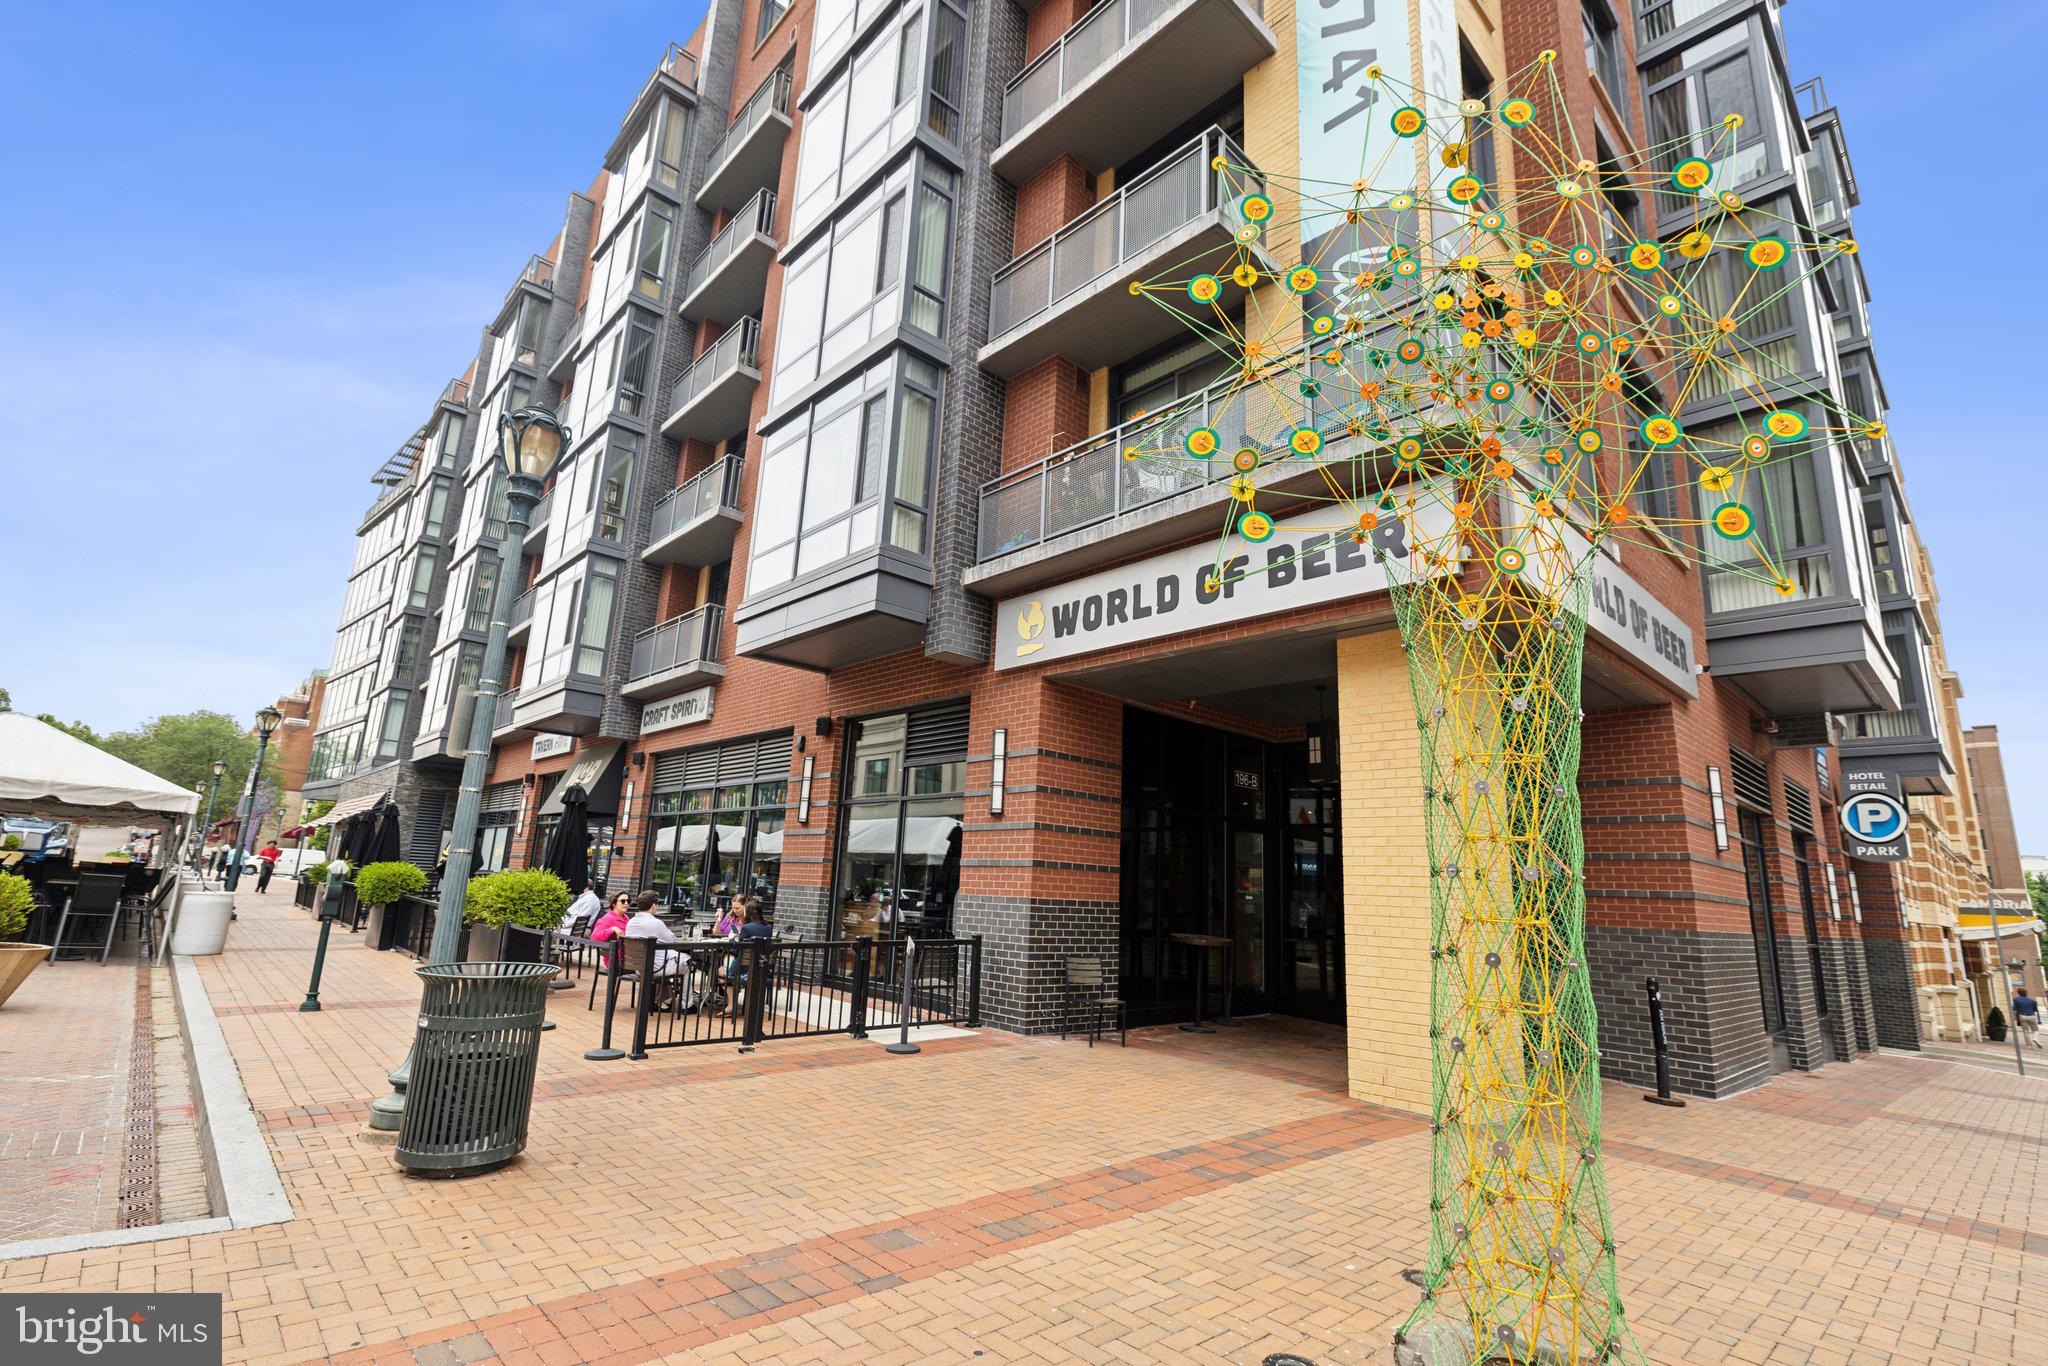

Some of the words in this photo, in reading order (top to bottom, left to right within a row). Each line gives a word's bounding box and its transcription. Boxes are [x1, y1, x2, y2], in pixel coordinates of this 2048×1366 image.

[1318, 0, 1379, 133] 741
[1052, 574, 1180, 638] WORLD
[1196, 554, 1250, 605] OF
[1267, 514, 1409, 588] BEER
[1592, 574, 1627, 628] RLD
[1629, 598, 1648, 643] OF
[1651, 616, 1689, 673] BEER
[643, 706, 671, 727] CRAFT
[1236, 772, 1258, 788] 196-B
[1848, 772, 1886, 780] HOTEL
[1849, 782, 1888, 791] RETAIL
[1856, 802, 1893, 834] P
[1856, 846, 1900, 856] PARK
